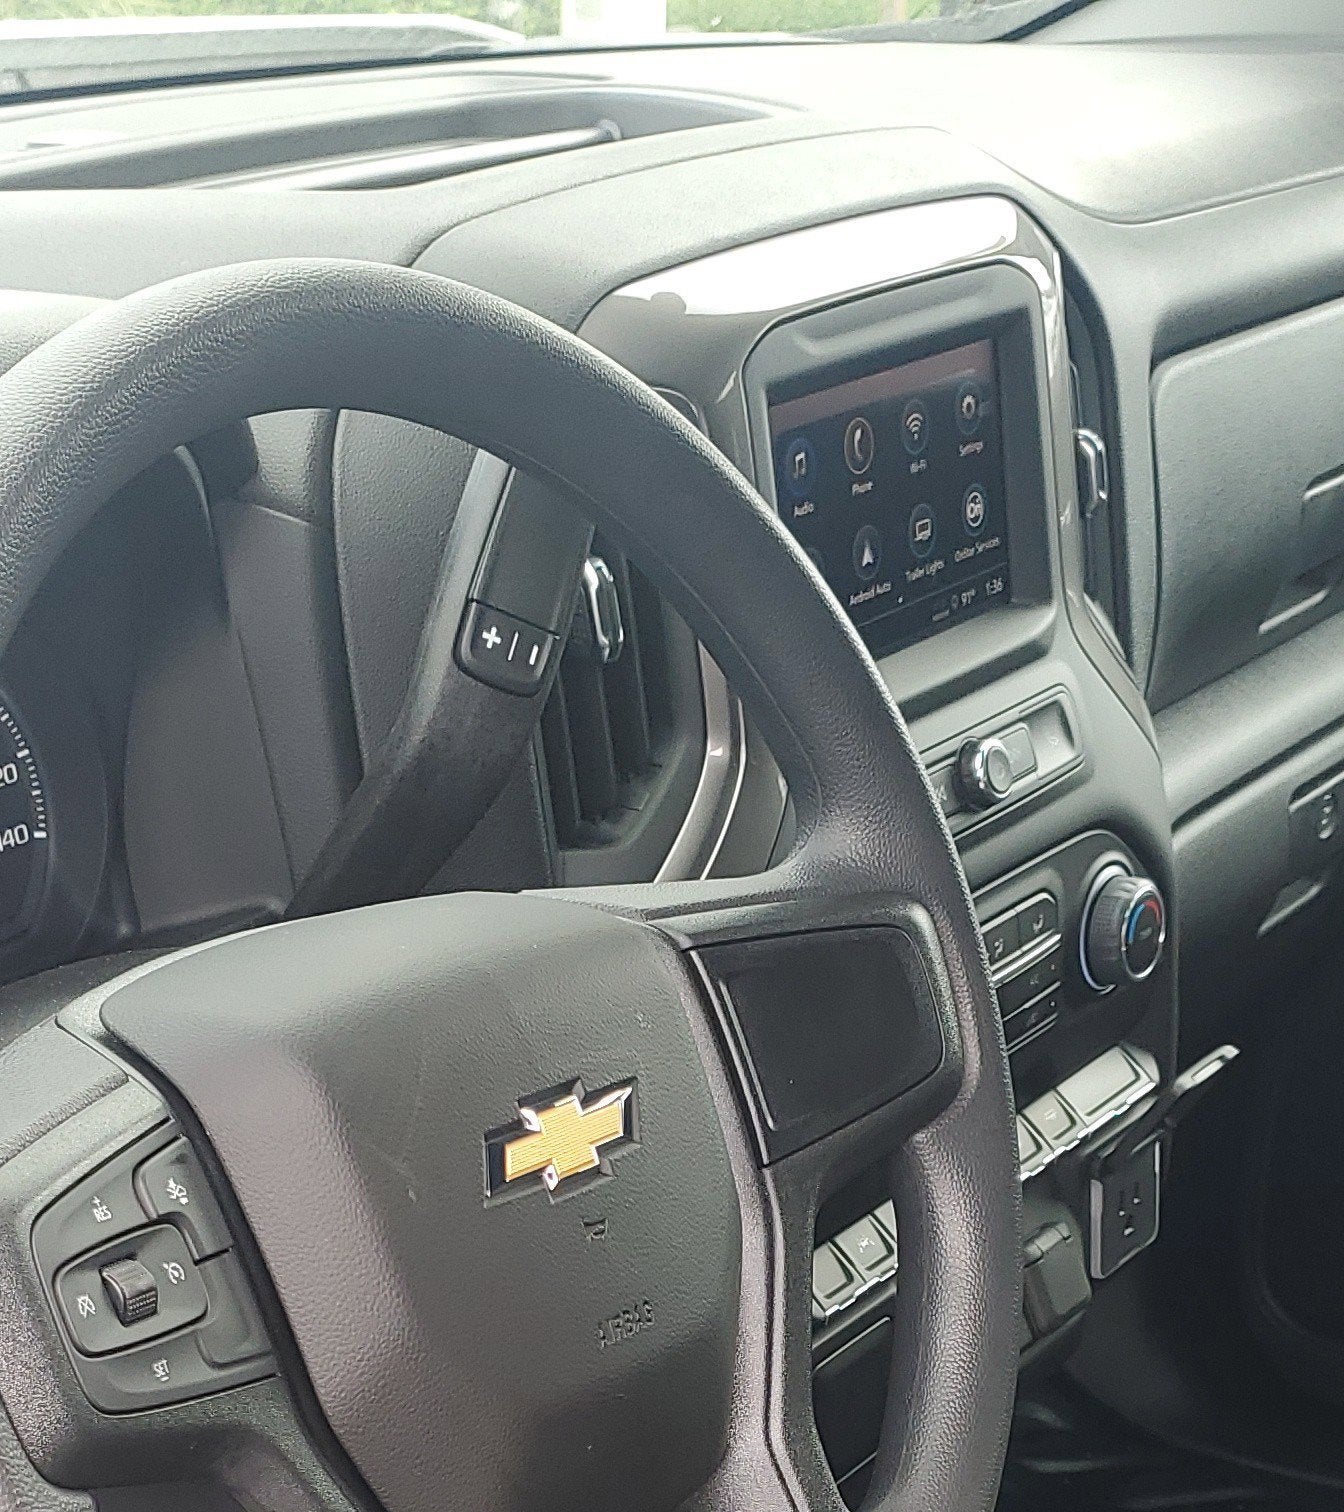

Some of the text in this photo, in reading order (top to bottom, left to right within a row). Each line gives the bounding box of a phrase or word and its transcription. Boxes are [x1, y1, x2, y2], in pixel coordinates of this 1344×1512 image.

[794, 501, 815, 518] Audio
[93, 1205, 113, 1223] RES
[153, 1358, 170, 1376] SET
